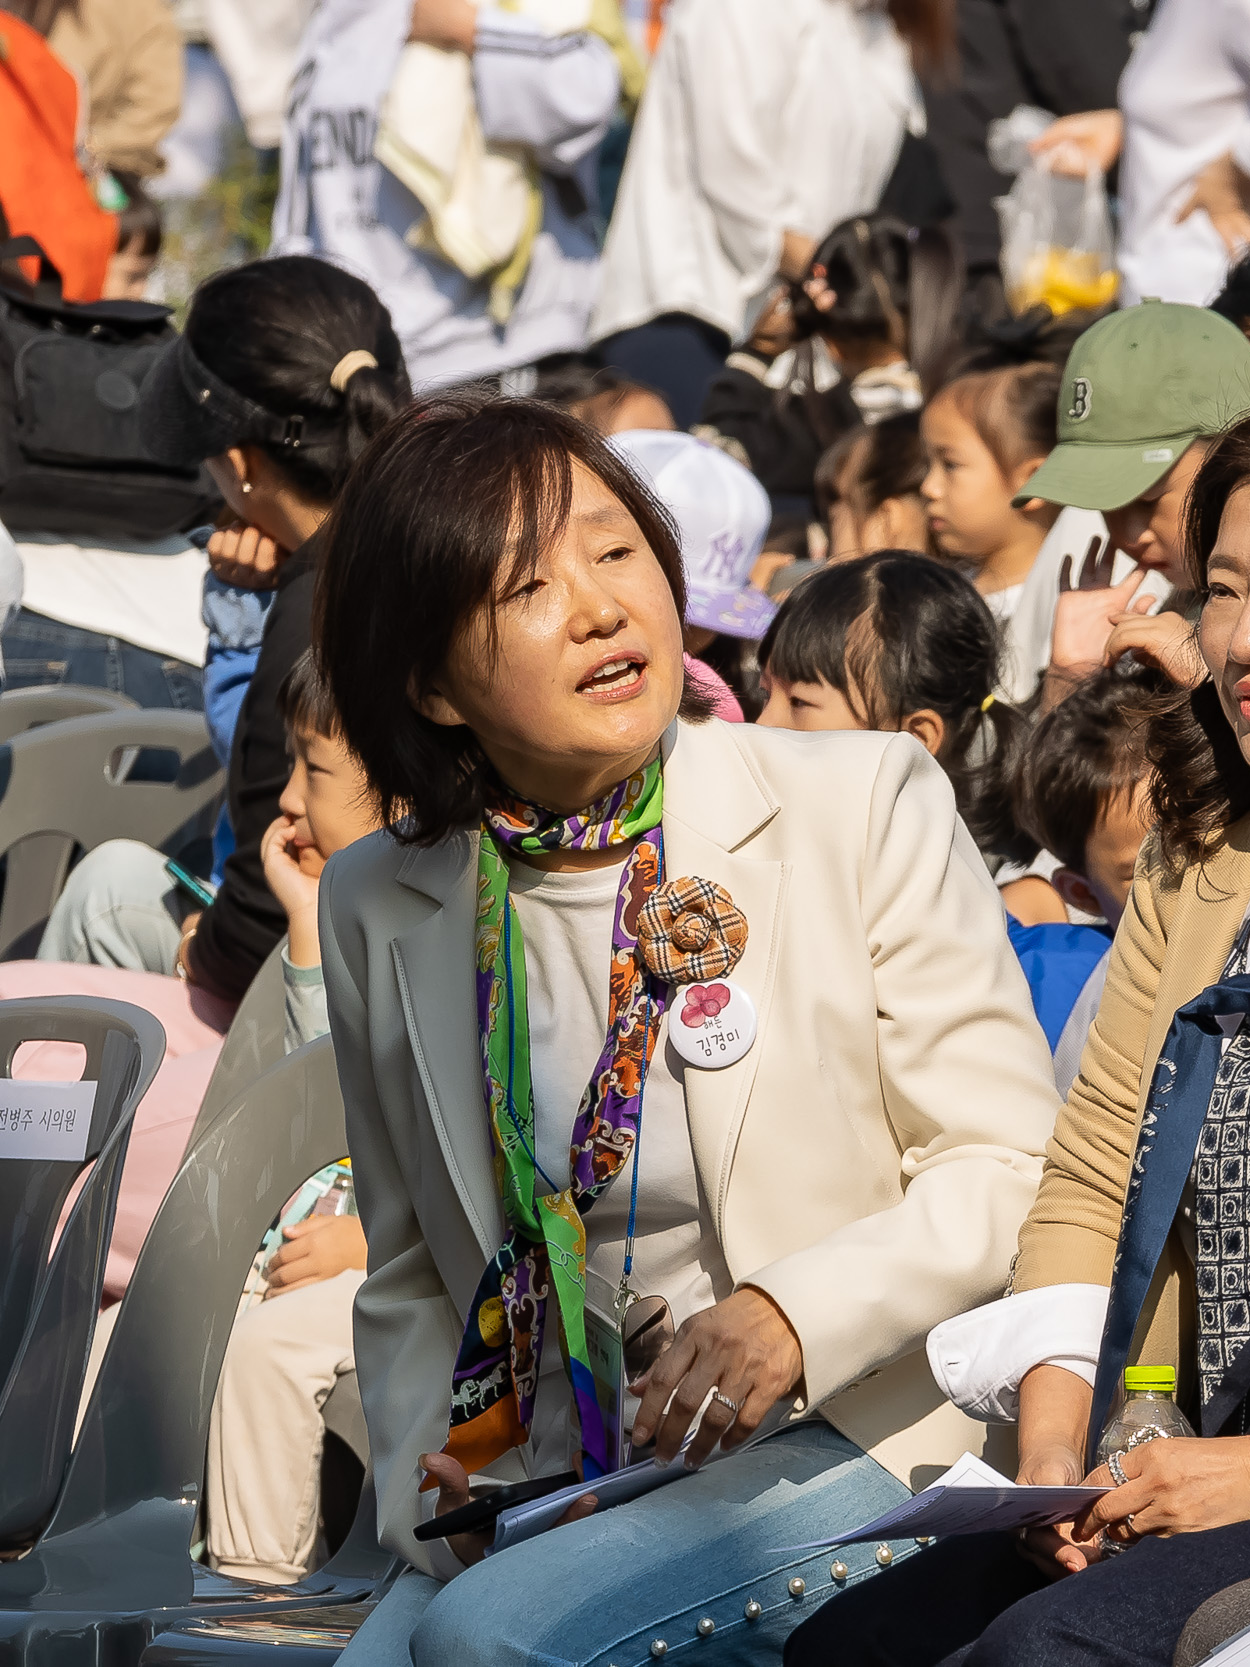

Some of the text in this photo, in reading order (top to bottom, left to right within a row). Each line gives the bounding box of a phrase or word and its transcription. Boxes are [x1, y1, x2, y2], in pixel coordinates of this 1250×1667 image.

[1068, 377, 1093, 421] B
[696, 1028, 740, 1056] 김경미
[39, 1109, 77, 1132] 시의원
